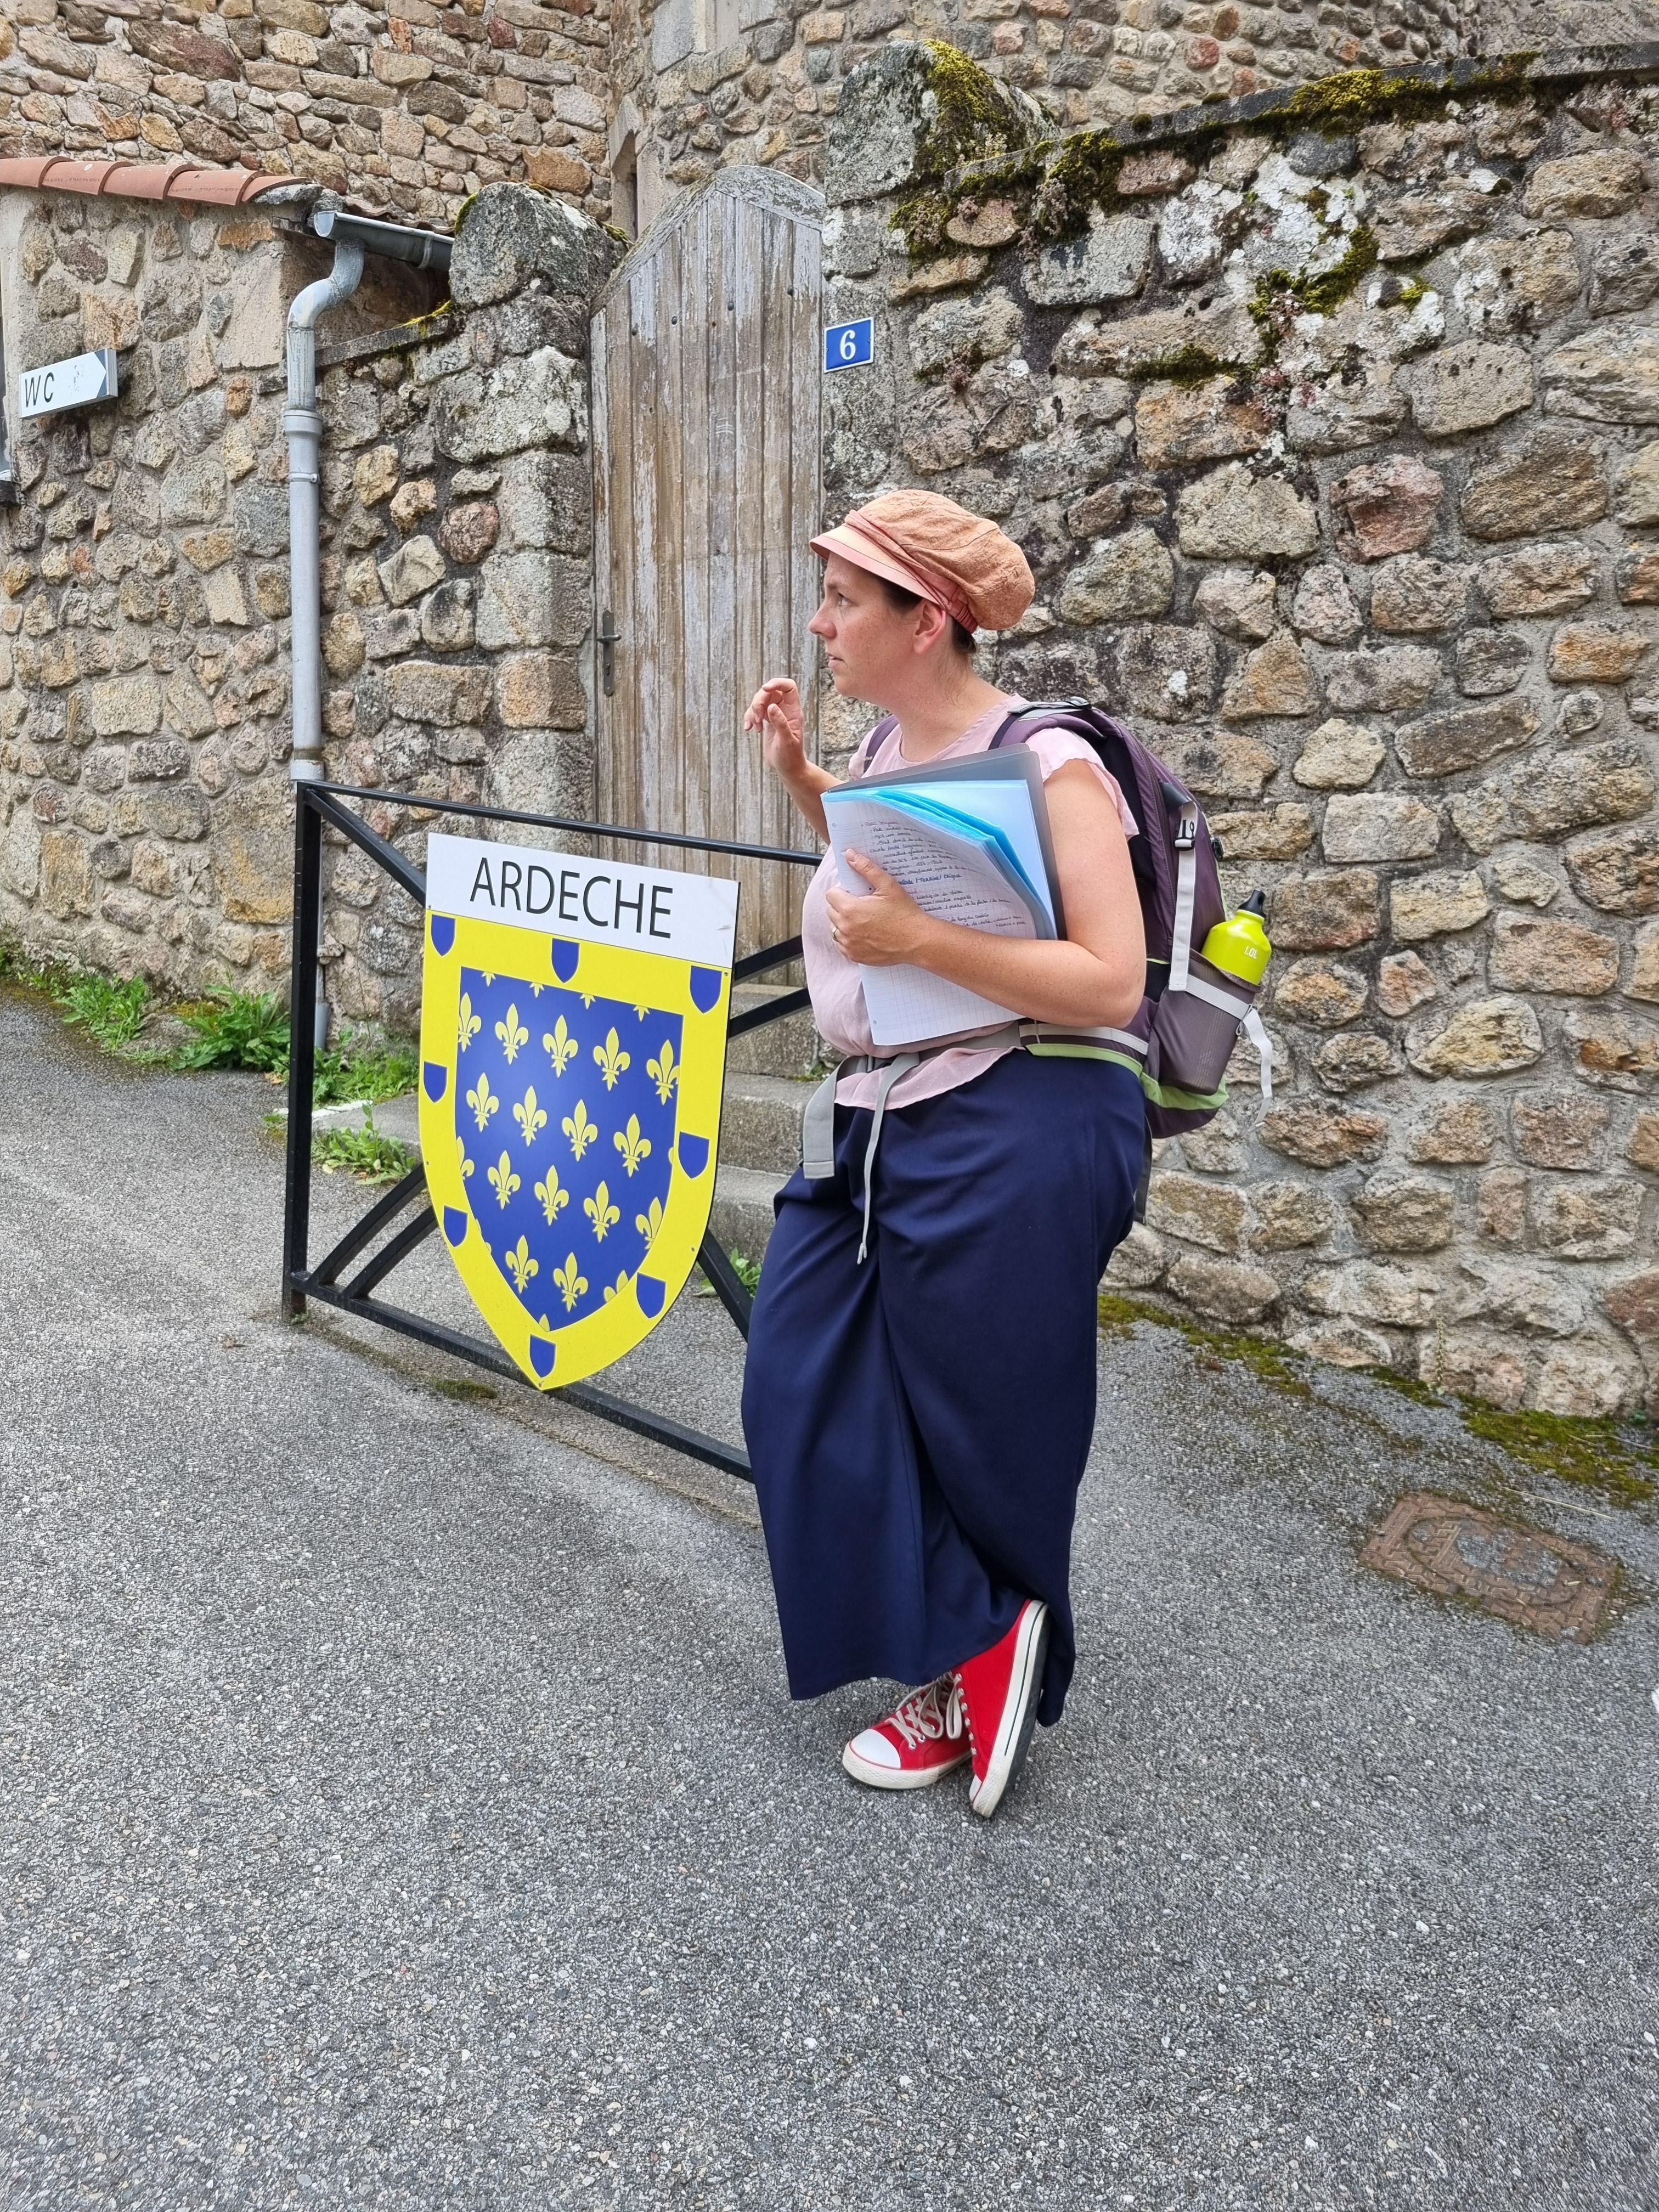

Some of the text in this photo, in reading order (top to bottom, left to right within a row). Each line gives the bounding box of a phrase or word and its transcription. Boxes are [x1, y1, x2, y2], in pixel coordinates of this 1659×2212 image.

[840, 330, 856, 360] 6
[25, 372, 54, 408] WC
[470, 857, 673, 939] ARDECHE
